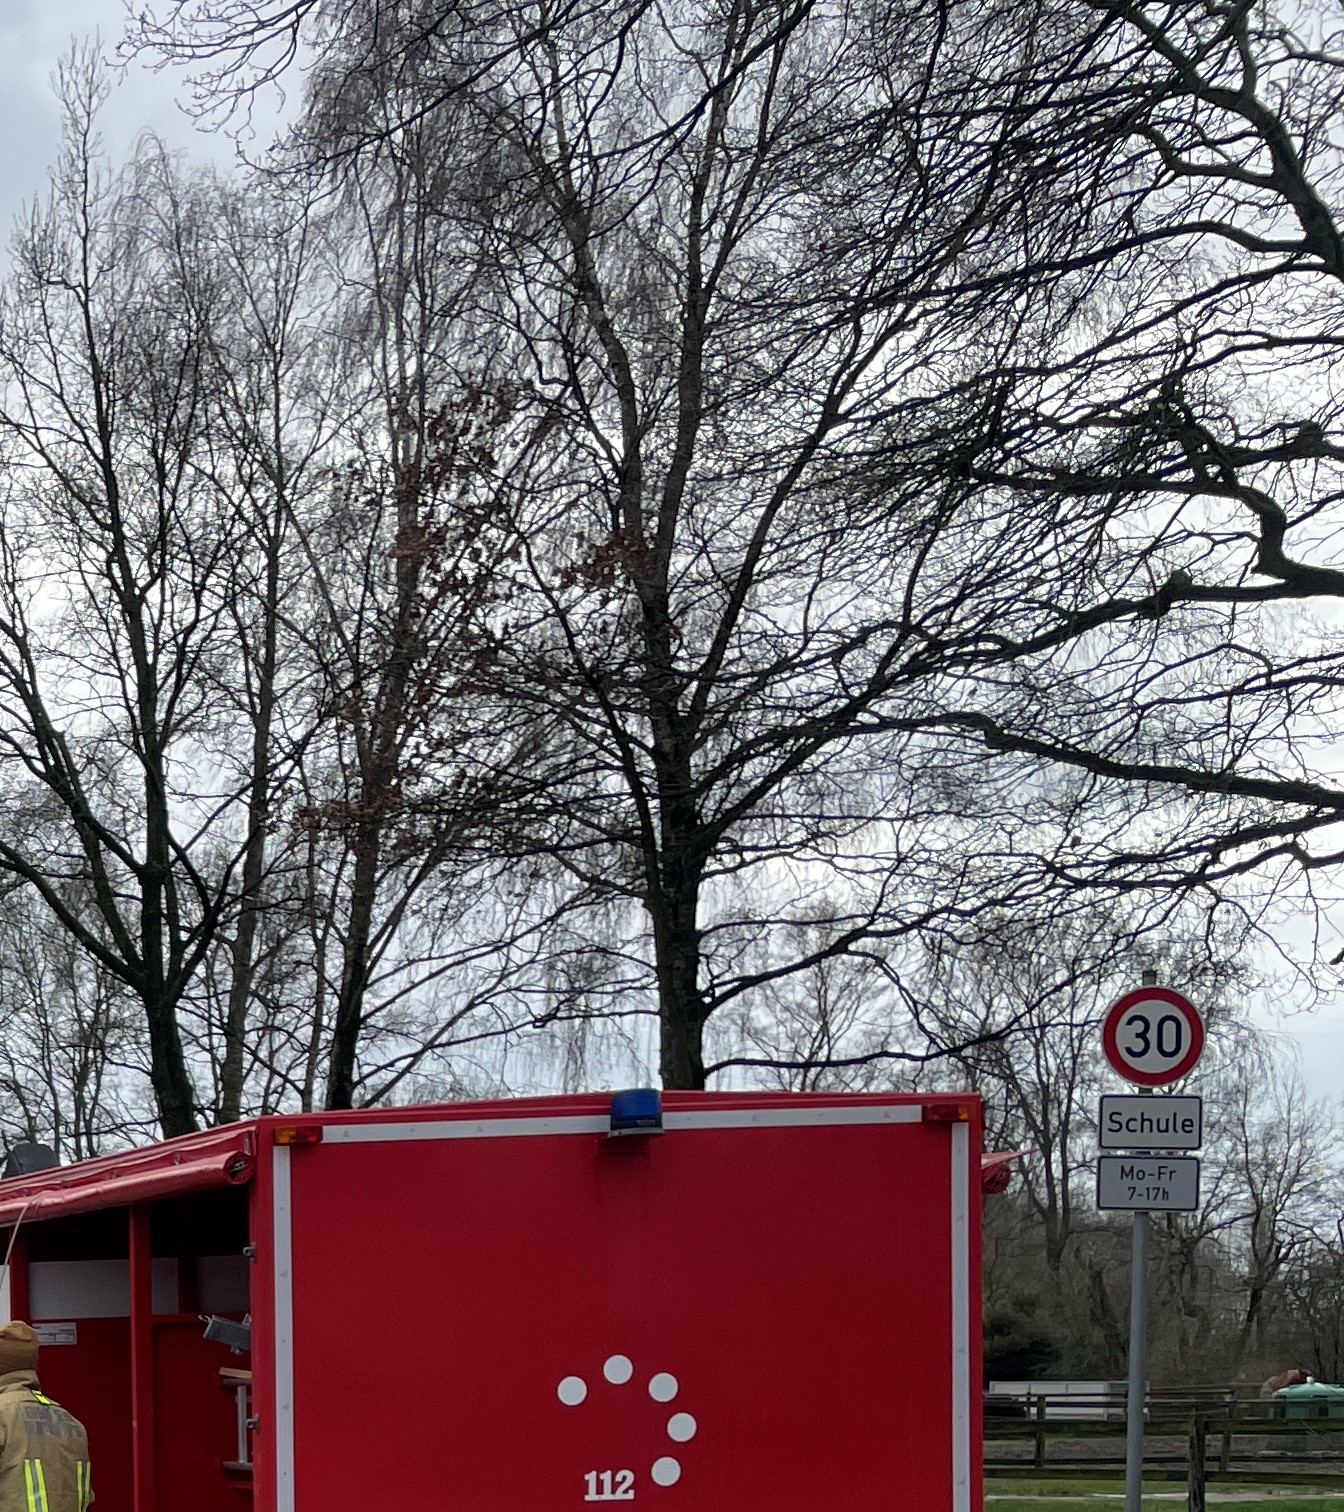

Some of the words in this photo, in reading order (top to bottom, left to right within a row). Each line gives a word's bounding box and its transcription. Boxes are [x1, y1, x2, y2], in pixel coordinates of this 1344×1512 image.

[1124, 1014, 1183, 1059] 30
[1107, 1111, 1195, 1135] Schule
[1120, 1165, 1177, 1183] Mo-Fr
[1127, 1186, 1170, 1202] 7-17h
[584, 1469, 635, 1501] 112
